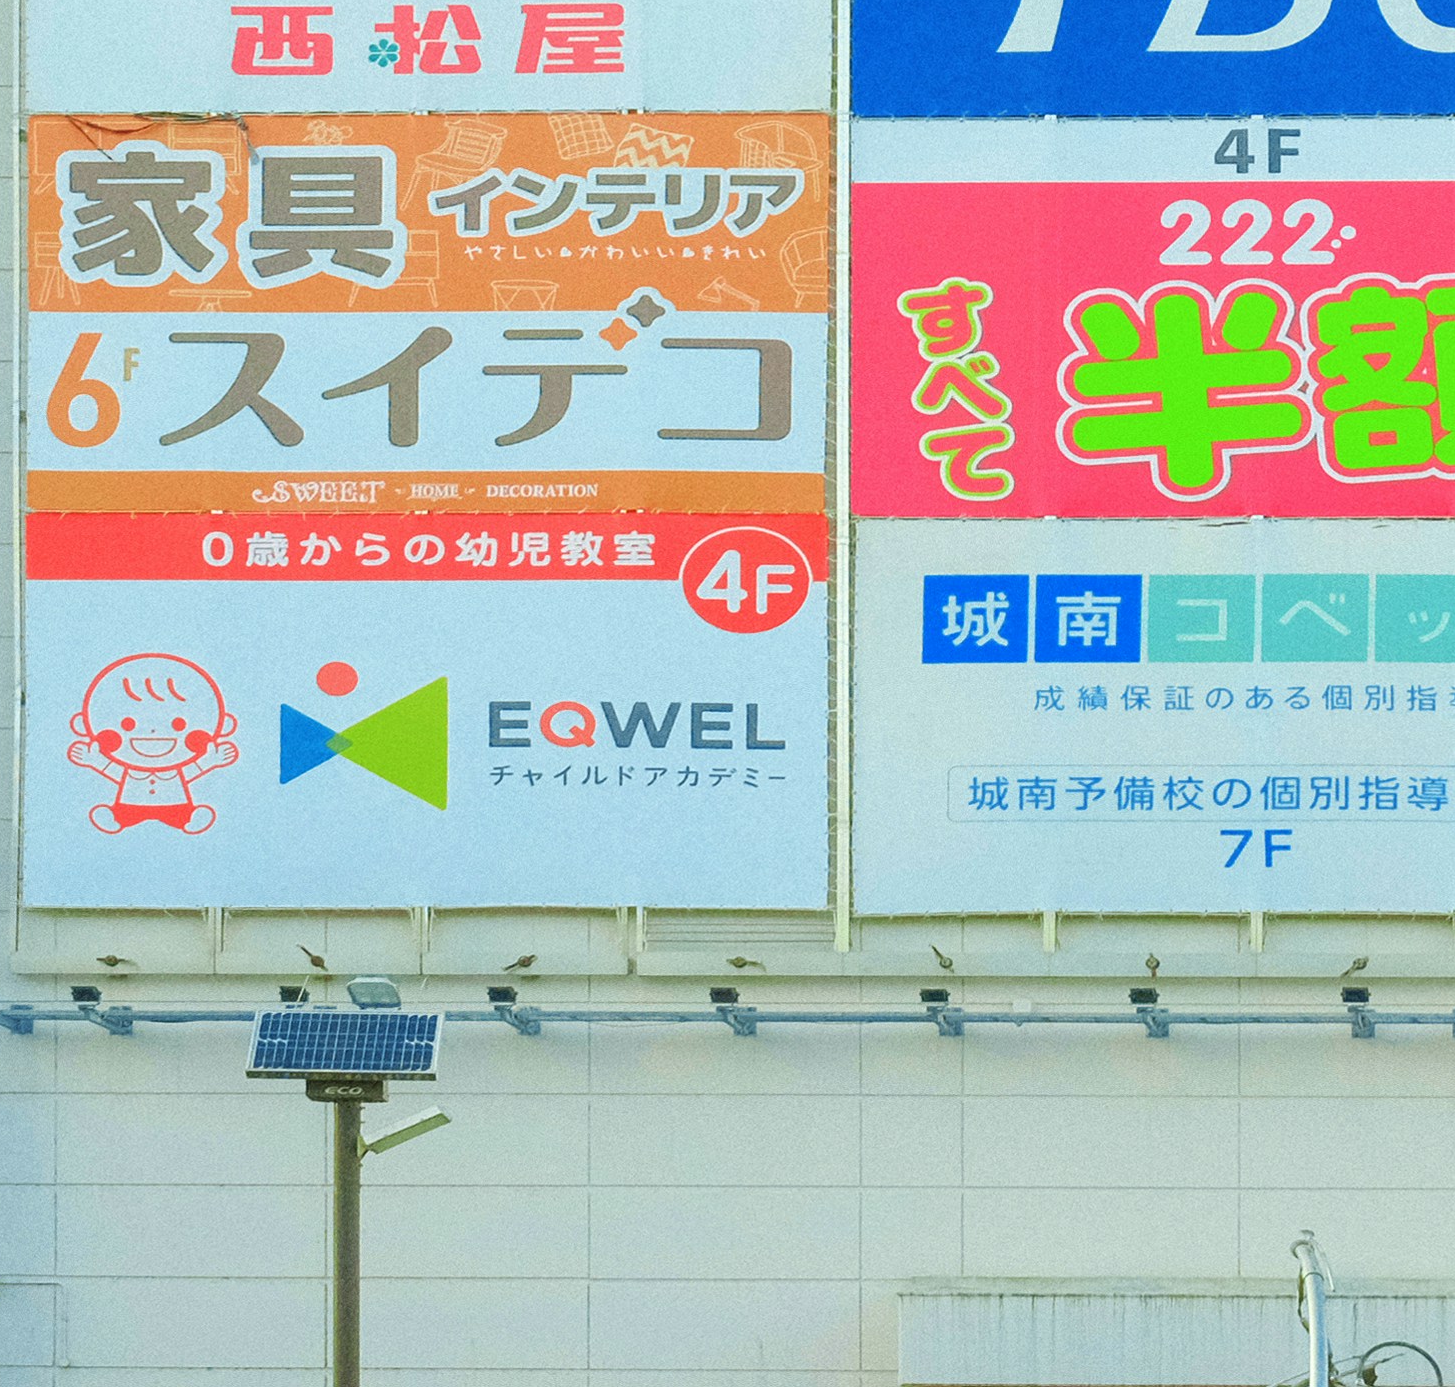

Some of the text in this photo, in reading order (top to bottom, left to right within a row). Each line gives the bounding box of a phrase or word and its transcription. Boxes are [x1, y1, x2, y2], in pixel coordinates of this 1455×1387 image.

[230, 2, 625, 77] 西松屋
[1214, 128, 1301, 174] 4F
[65, 150, 801, 282] 家具 インテリア
[158, 323, 793, 448] スイデコ
[897, 277, 1015, 500] すべて
[251, 480, 599, 504] SWEET HOME DECORATION
[202, 529, 656, 568] 0歳からの幼児教室
[696, 550, 795, 615] 4F
[488, 700, 787, 751] EQWEL
[490, 764, 787, 789] チャイルドアカデミー
[1219, 829, 1294, 870] 7F
[325, 1086, 363, 1095] ECO
